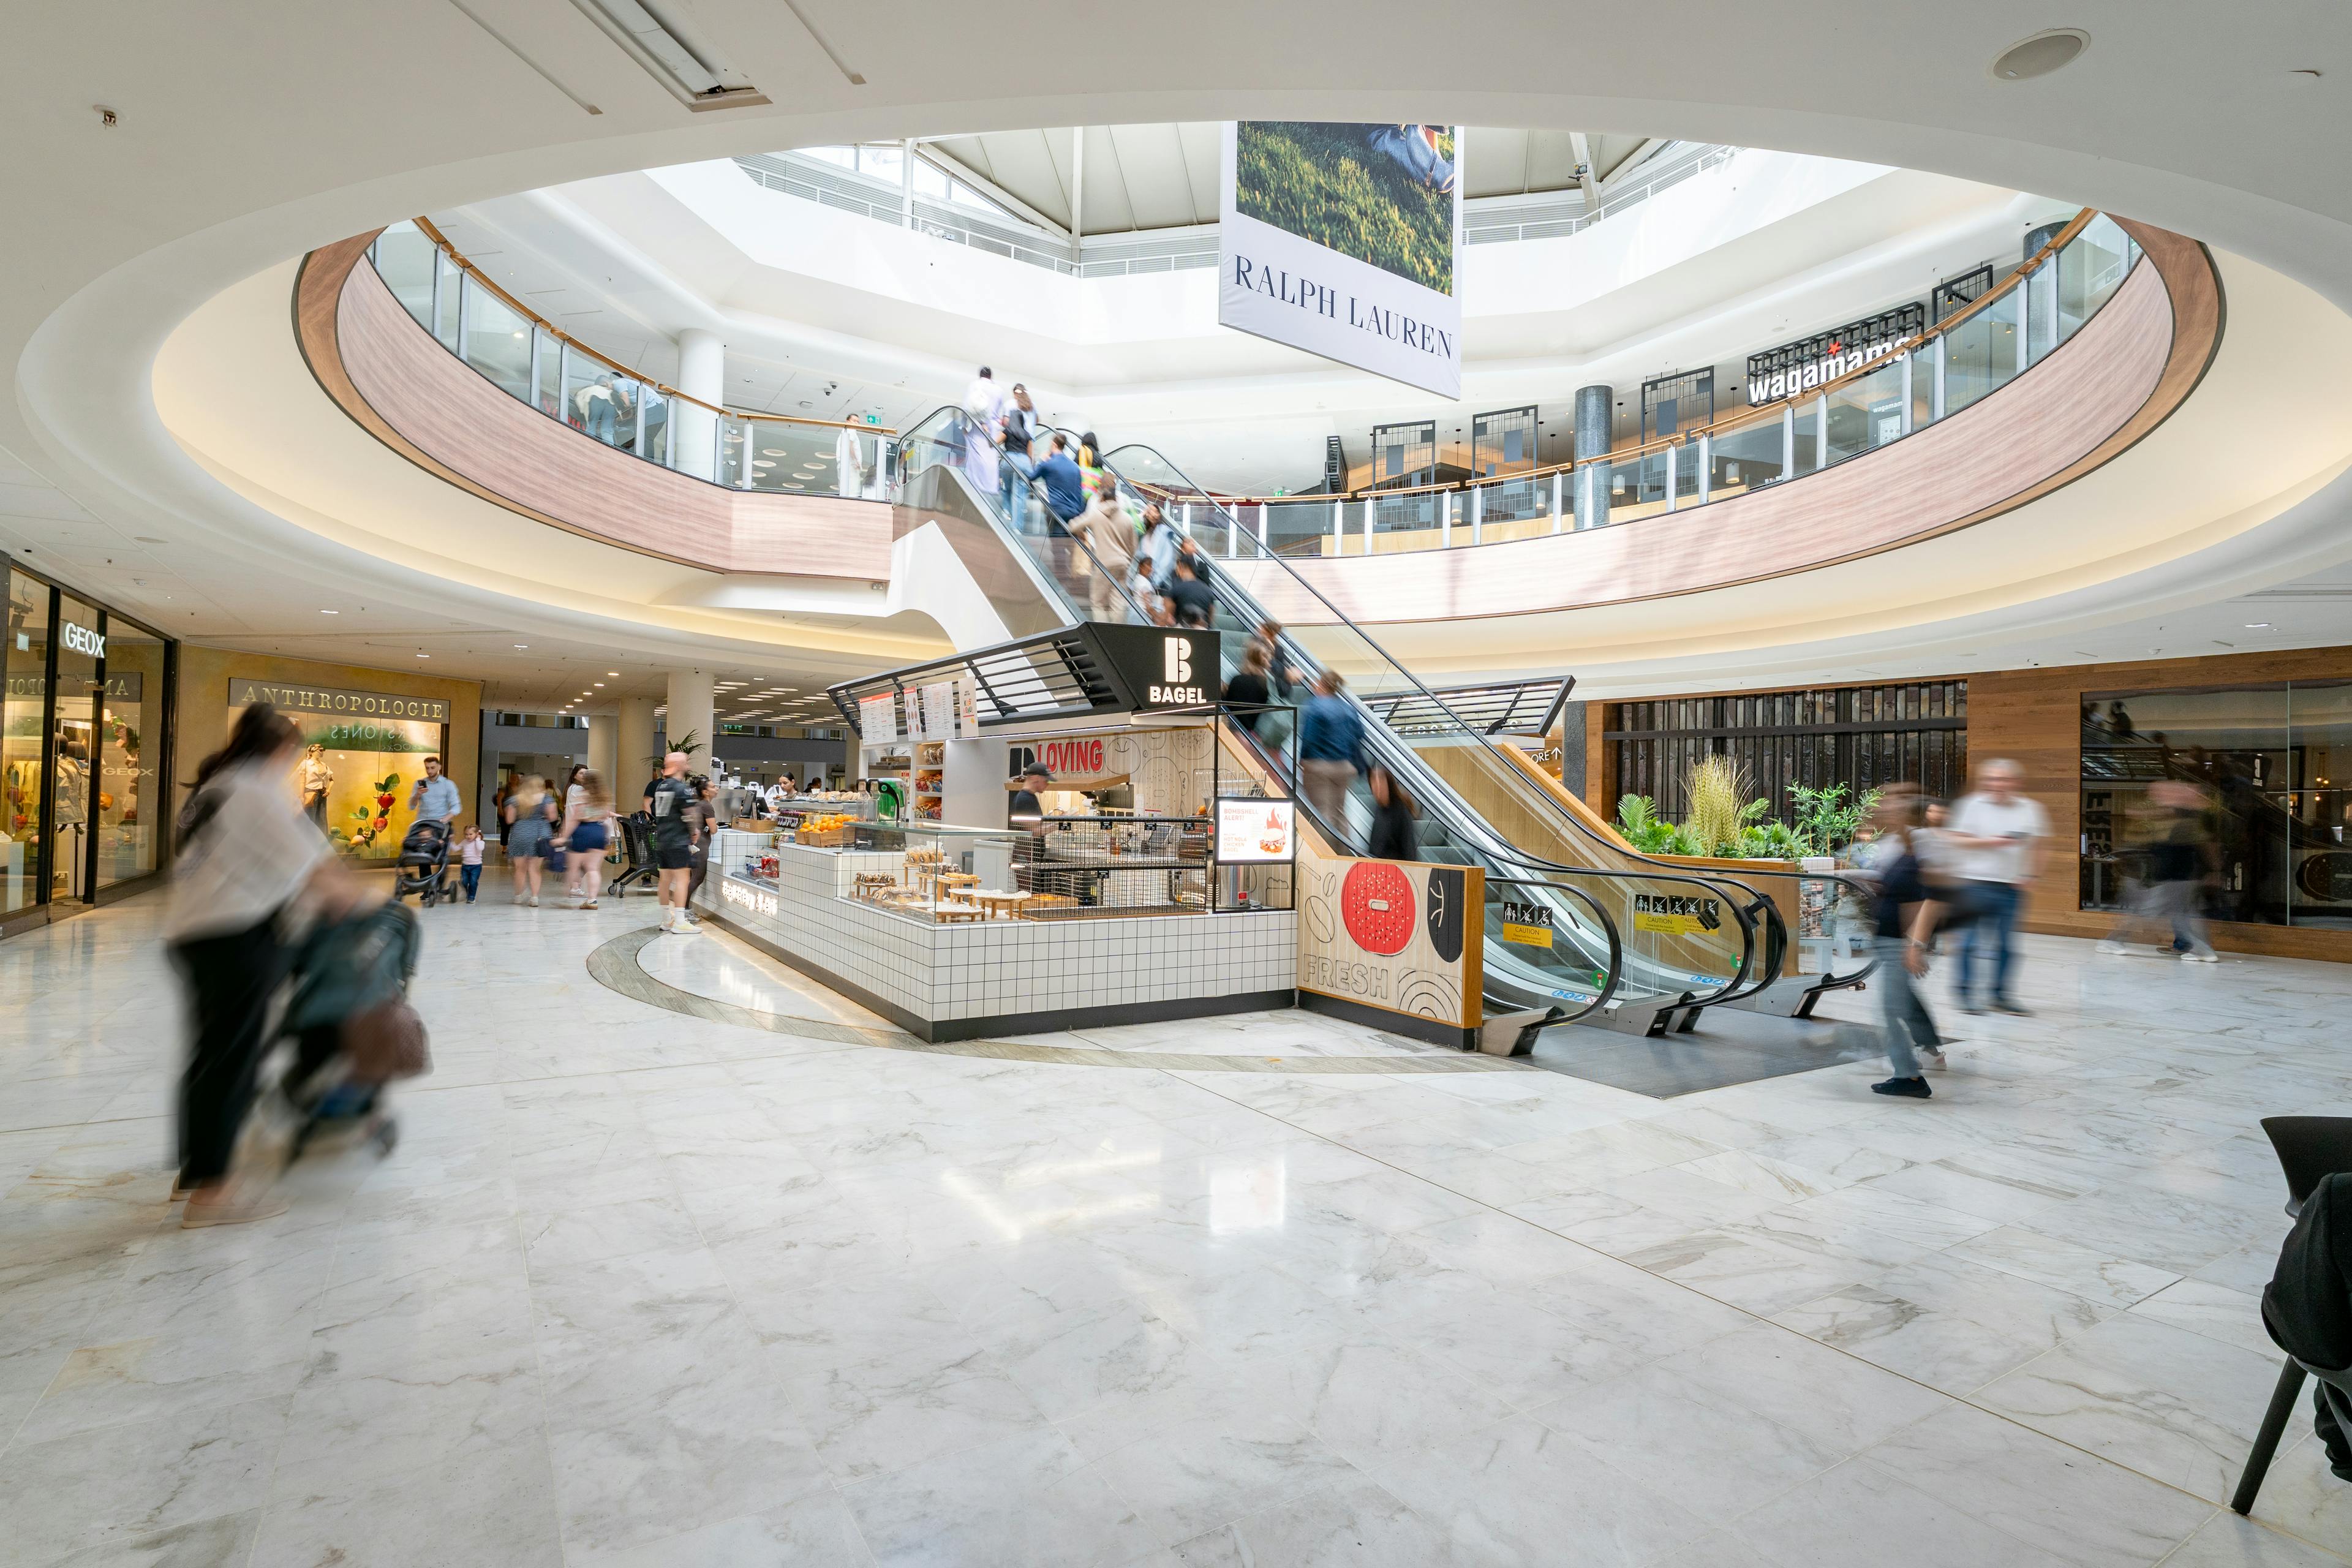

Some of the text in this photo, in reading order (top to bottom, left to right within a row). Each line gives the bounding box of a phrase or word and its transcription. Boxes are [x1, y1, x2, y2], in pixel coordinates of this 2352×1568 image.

[1235, 254, 1452, 360] RALPH LAUREN
[66, 622, 105, 658] GEOX
[242, 686, 442, 718] ANTHROPOLOGIE
[1150, 686, 1207, 703] BAGEL
[103, 767, 153, 776] GEOX
[1515, 927, 1539, 935] CAUTION
[1303, 954, 1388, 1000] FRESH
